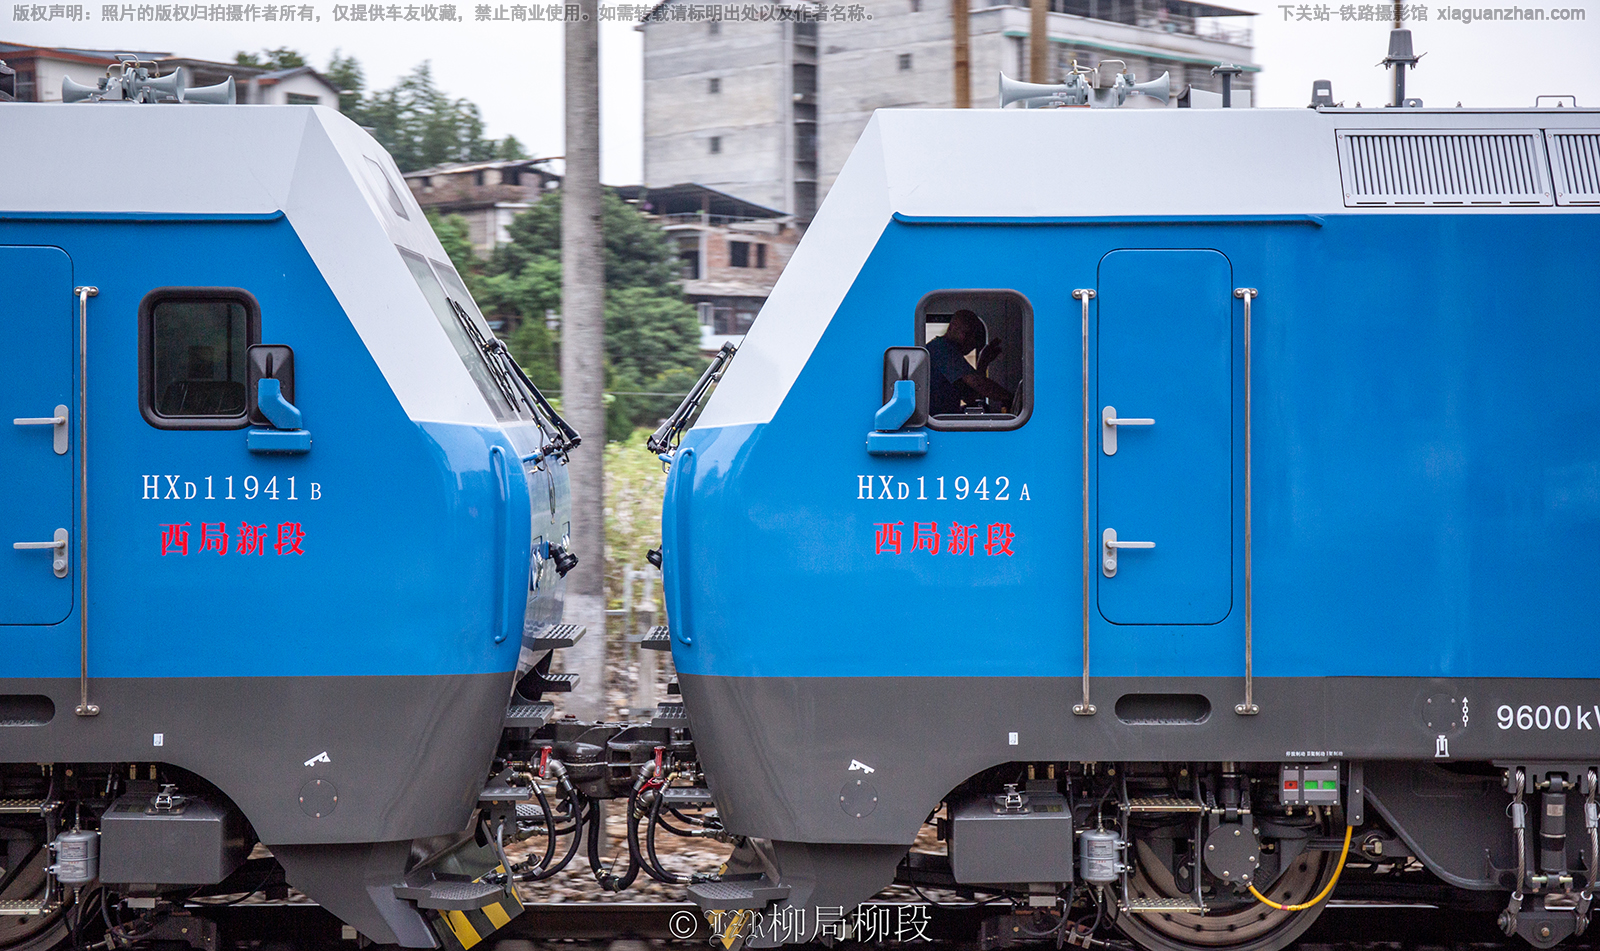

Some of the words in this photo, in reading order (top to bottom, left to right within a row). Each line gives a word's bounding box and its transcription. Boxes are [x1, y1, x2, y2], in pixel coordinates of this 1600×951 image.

[142, 475, 298, 500] HXD11941
[310, 482, 322, 500] B
[857, 475, 1010, 500] HXD11942
[1019, 483, 1031, 501] A
[159, 521, 306, 556] 西局新段
[873, 520, 1016, 557] 西局新段
